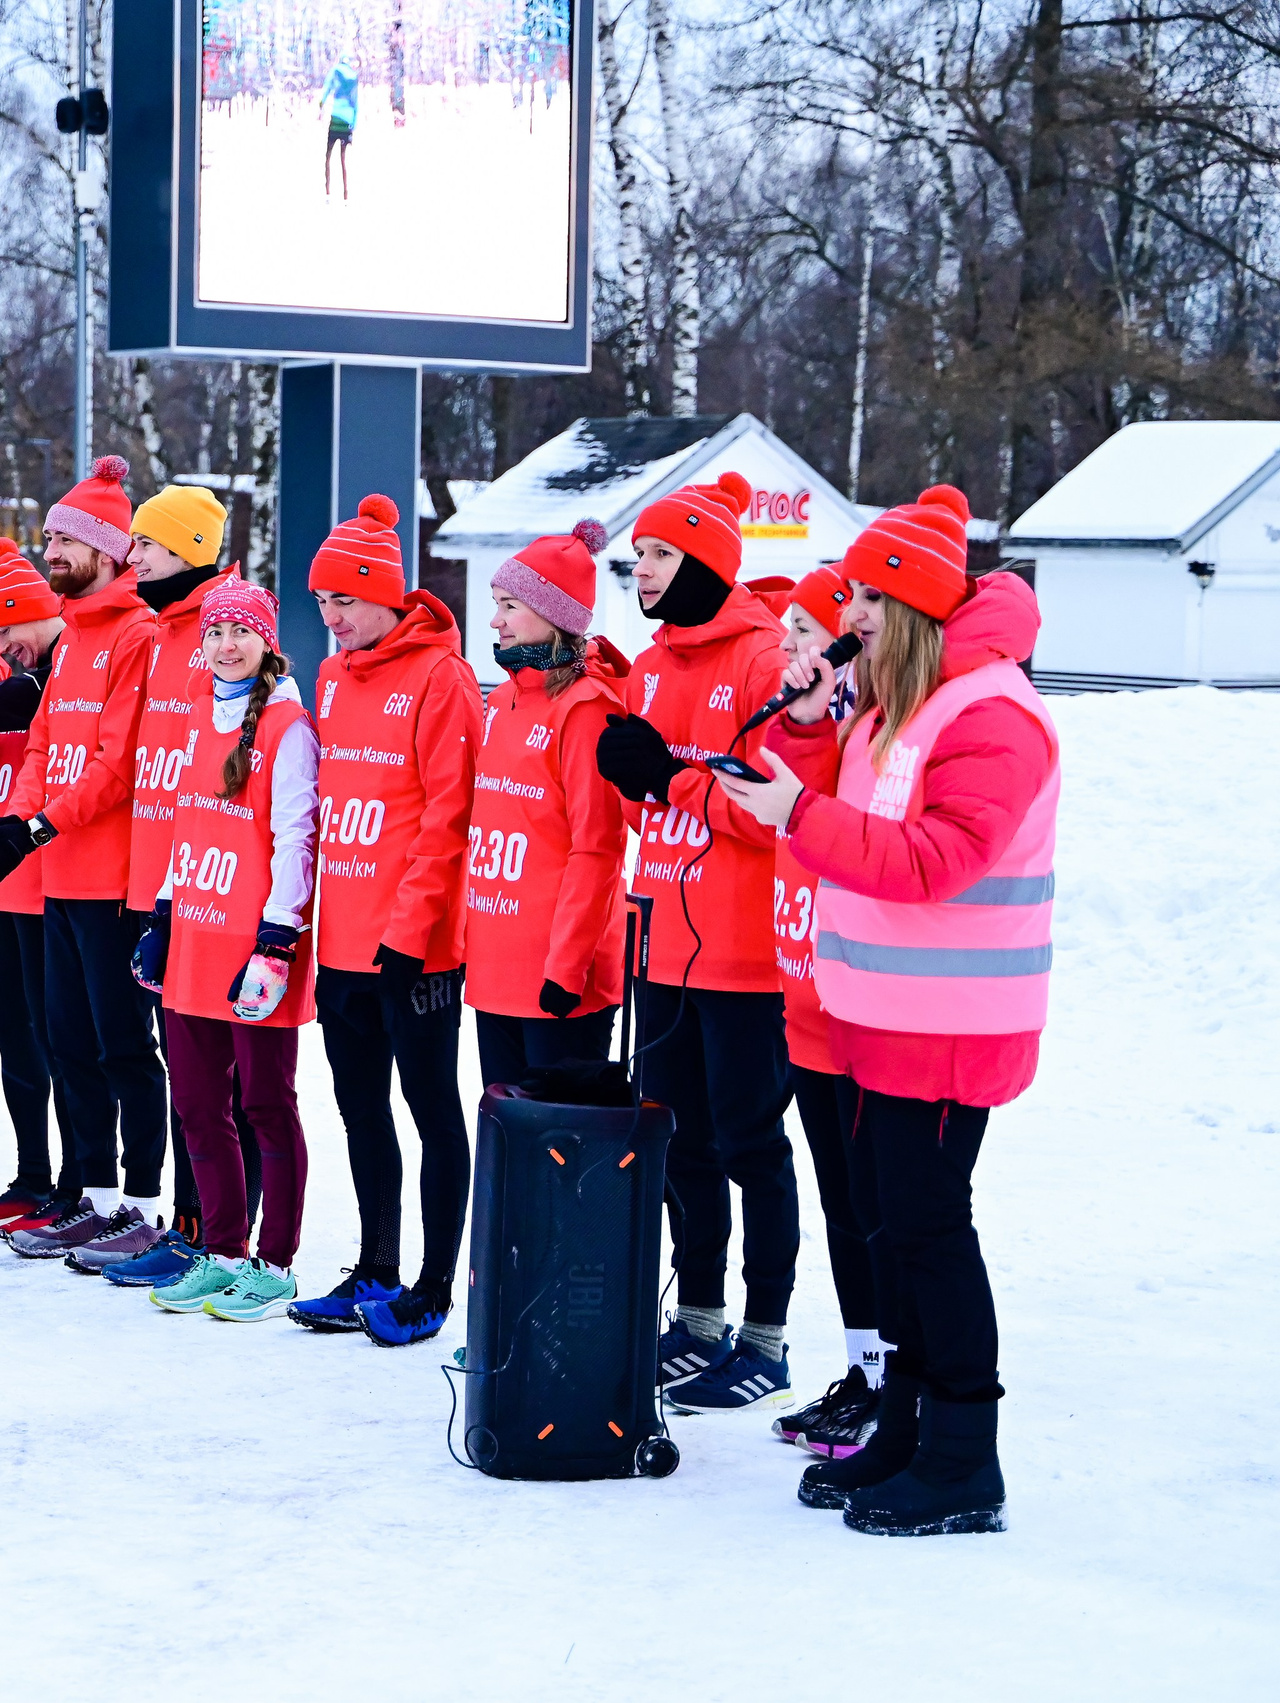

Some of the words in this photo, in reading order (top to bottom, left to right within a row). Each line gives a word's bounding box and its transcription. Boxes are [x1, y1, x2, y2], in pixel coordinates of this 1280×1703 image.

[383, 692, 414, 717] GRi
[525, 723, 554, 750] GRi
[361, 746, 406, 766] Маяков
[883, 740, 920, 780] Sat
[500, 776, 545, 800] Маяков
[872, 774, 913, 807] 9AM
[219, 799, 255, 821] Маяков
[328, 854, 377, 879] мин/км
